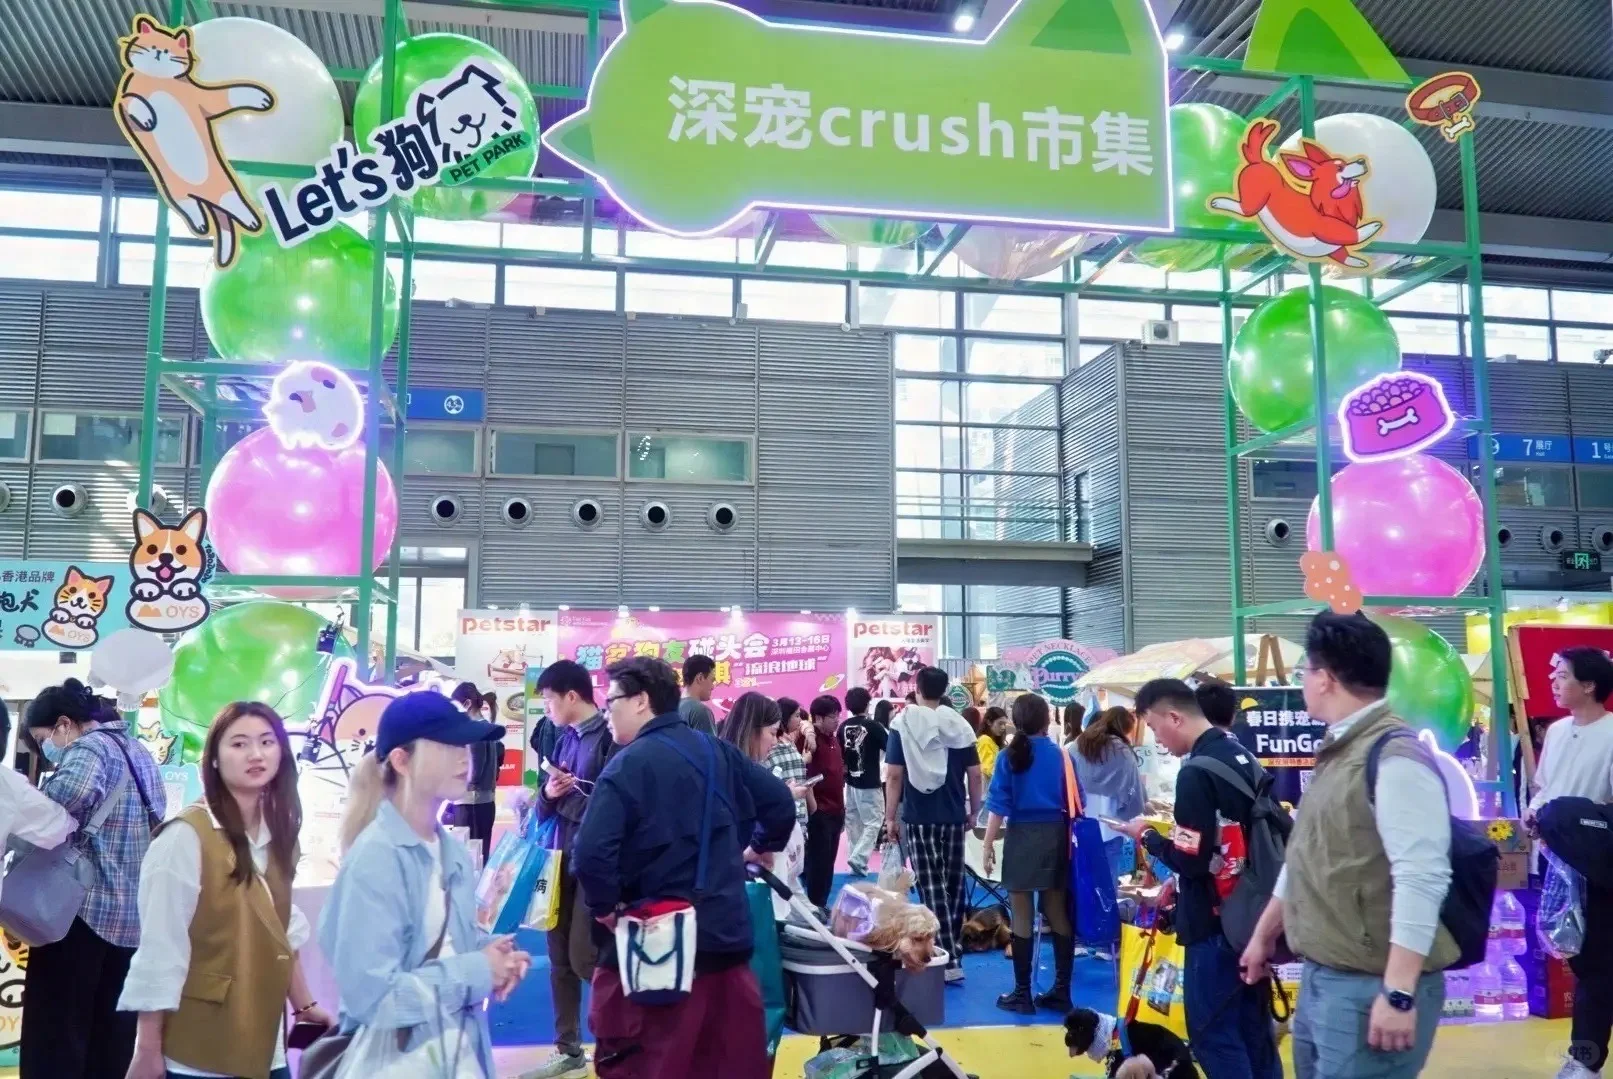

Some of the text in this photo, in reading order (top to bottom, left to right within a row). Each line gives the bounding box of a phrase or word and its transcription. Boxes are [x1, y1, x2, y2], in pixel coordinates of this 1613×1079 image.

[667, 75, 1154, 176] 深宠crush市集
[449, 134, 526, 182] PET PARK
[2, 570, 55, 583] 香港品牌
[166, 605, 200, 618] OYS
[462, 617, 551, 635] petstar
[853, 622, 933, 638] petstar
[1246, 710, 1325, 727] 春日携宠
[164, 771, 189, 781] OYS
